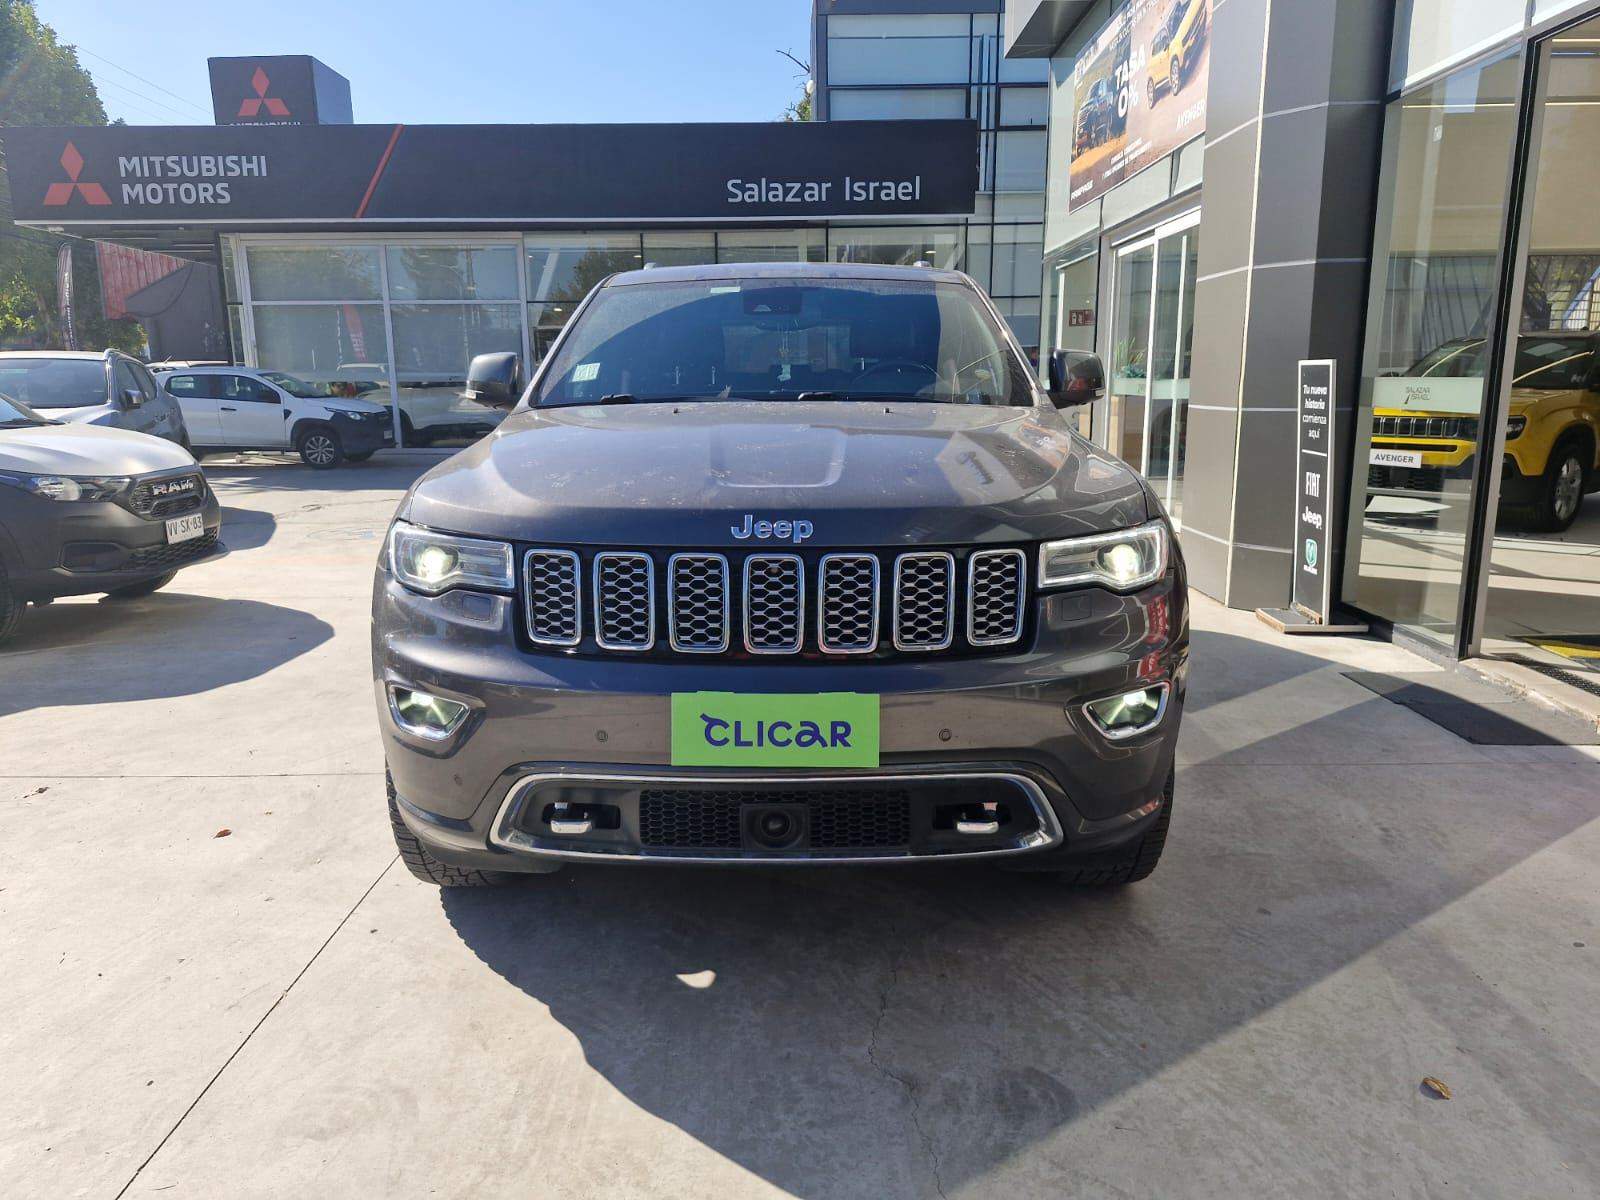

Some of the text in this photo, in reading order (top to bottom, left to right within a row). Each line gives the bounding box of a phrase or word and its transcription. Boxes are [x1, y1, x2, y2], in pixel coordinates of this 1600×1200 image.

[118, 155, 268, 178] MITSUBISHI
[122, 183, 231, 205] MOTORS
[726, 175, 921, 203] Salazar Israel
[1375, 453, 1414, 463] AVENGER
[152, 479, 194, 496] RAM
[1305, 472, 1320, 498] FIAT
[730, 514, 814, 543] Jeep
[1302, 506, 1322, 530] Jeep
